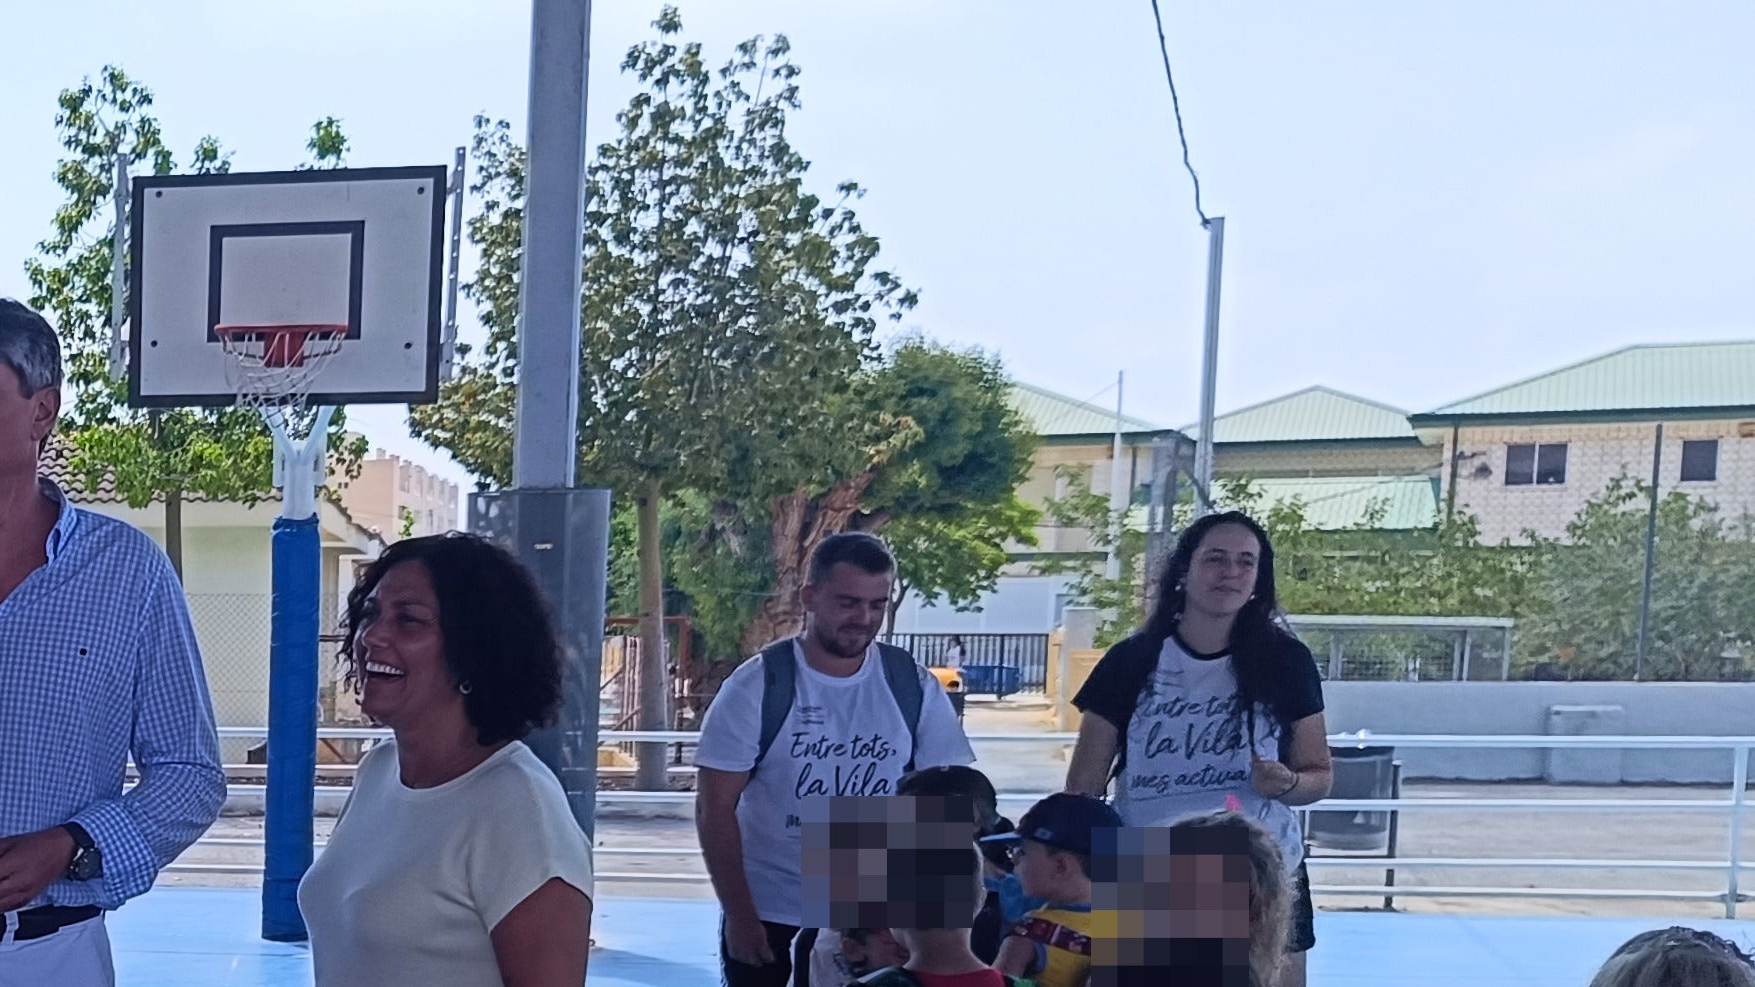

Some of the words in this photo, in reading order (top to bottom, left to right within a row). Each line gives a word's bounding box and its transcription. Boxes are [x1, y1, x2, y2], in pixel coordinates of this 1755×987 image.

[790, 732, 847, 760] Entre
[851, 733, 897, 761] tots,
[1145, 721, 1180, 759] la
[795, 762, 829, 800] la
[834, 762, 893, 797] Vila
[1174, 763, 1248, 787] activa
